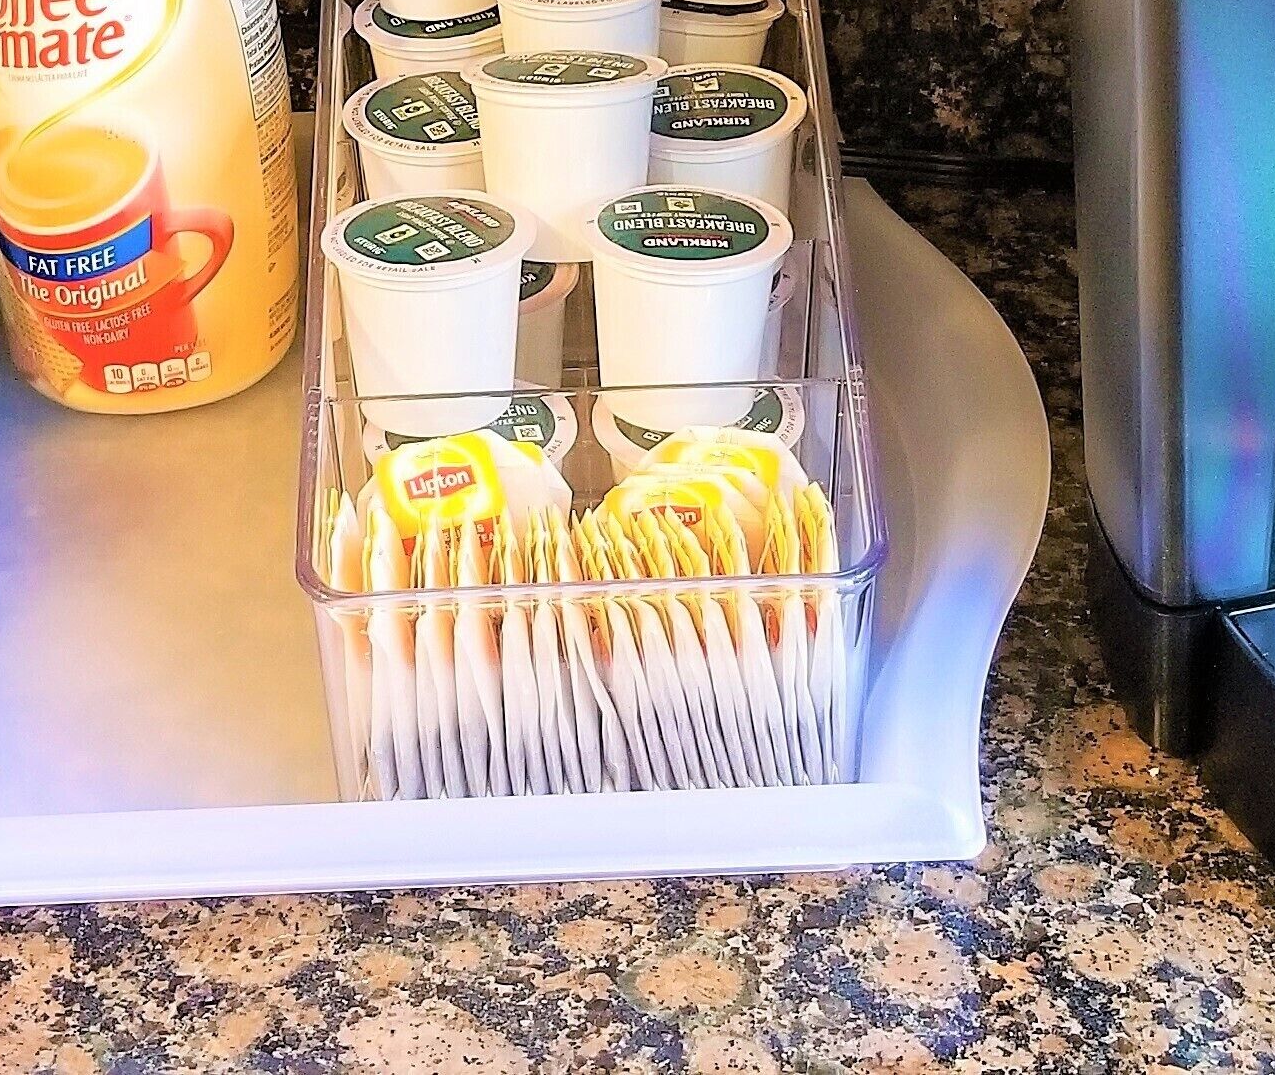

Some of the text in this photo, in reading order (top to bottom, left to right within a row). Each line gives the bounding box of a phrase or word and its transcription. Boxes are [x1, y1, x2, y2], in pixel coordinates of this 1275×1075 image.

[0, 20, 126, 68] mate
[654, 97, 776, 115] BREAKFAST BLEN
[670, 116, 750, 130] KIRKLAND
[447, 222, 486, 249] BLEND
[613, 217, 757, 235] BREAKFAST BLEND
[643, 236, 729, 249] KIRKLAND
[28, 245, 117, 276] FAT FREE
[19, 258, 148, 310] The Original
[43, 316, 72, 333] GLUTEN
[95, 312, 131, 331] LACTOSE
[131, 302, 153, 320] FREE
[83, 327, 130, 346] NON-DAIRY
[110, 368, 124, 380] 10
[410, 470, 471, 498] Lipton
